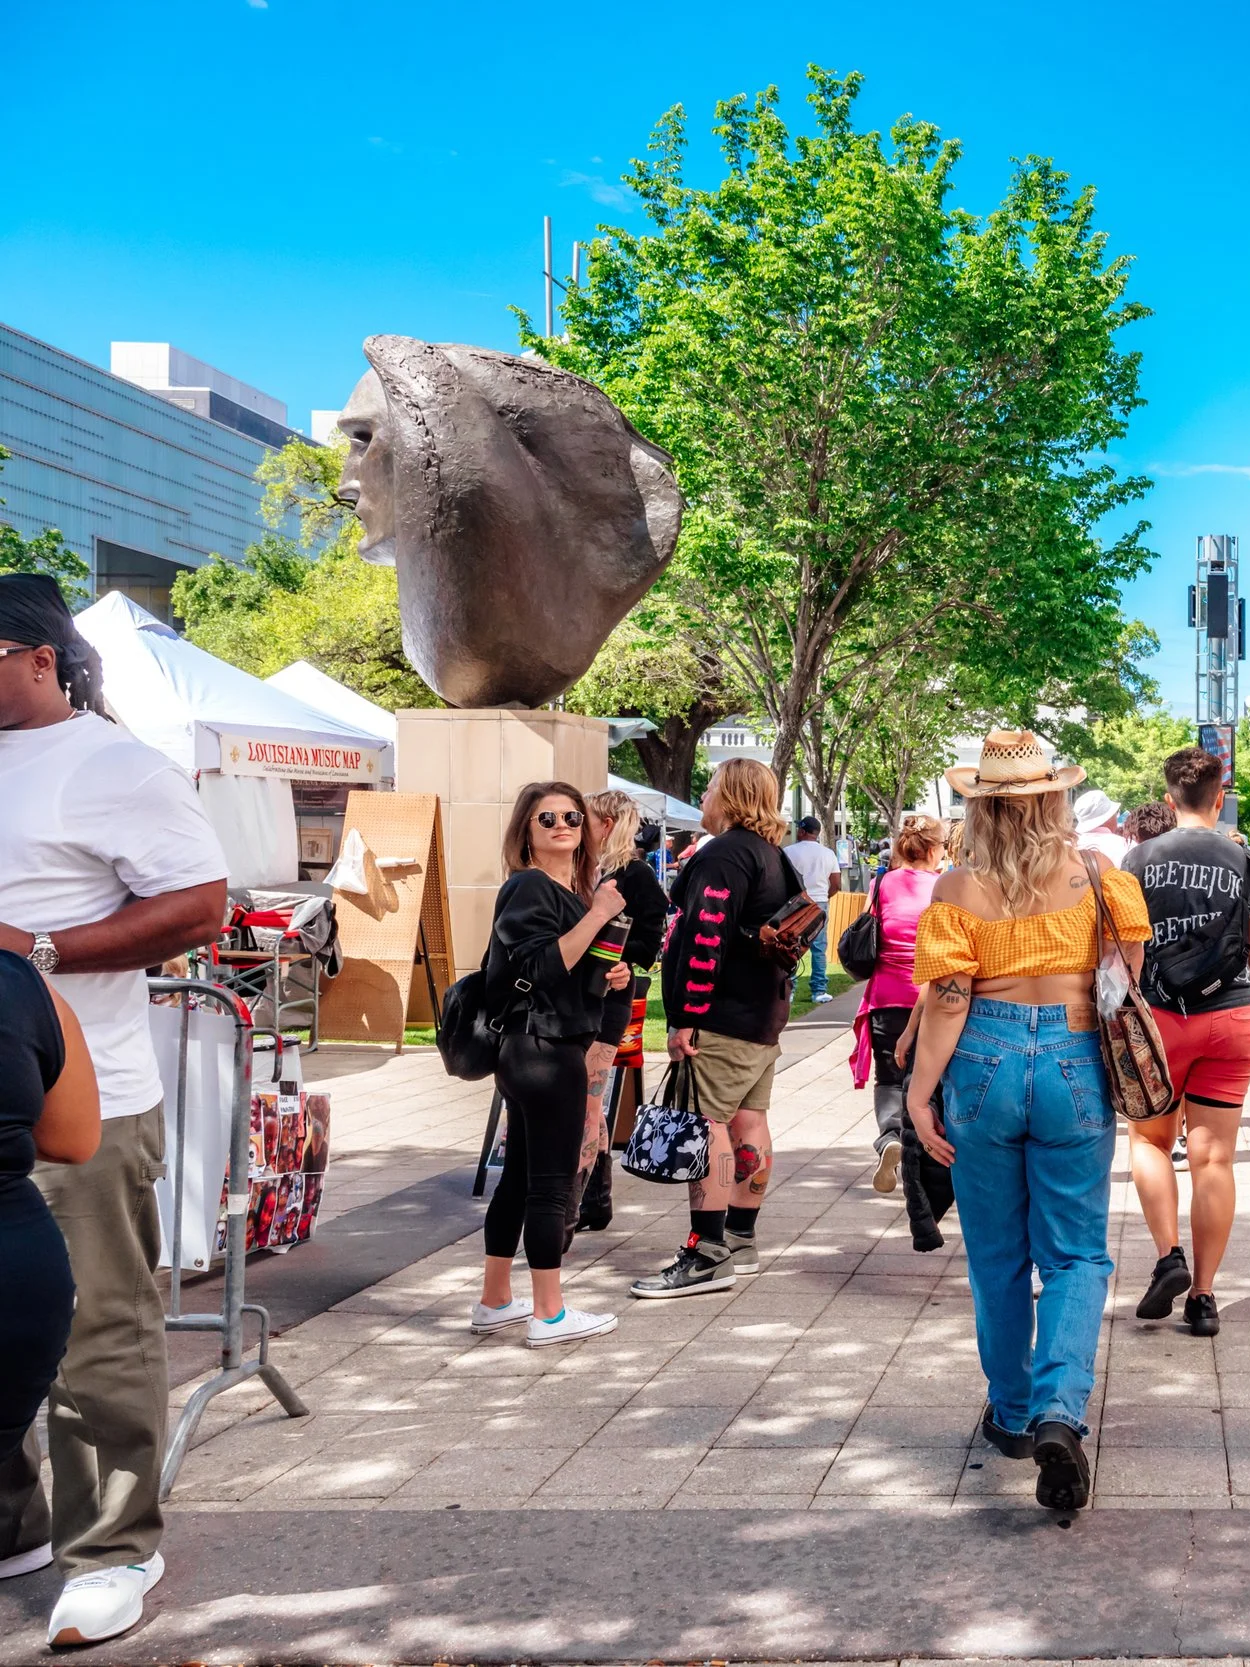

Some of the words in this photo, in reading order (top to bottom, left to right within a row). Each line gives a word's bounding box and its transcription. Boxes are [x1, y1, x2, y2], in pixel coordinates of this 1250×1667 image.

[248, 742, 309, 766] LOUISIANA
[310, 748, 341, 768] MUSIC
[343, 751, 361, 769] MAP
[1144, 861, 1243, 900] BEETLEJUIC
